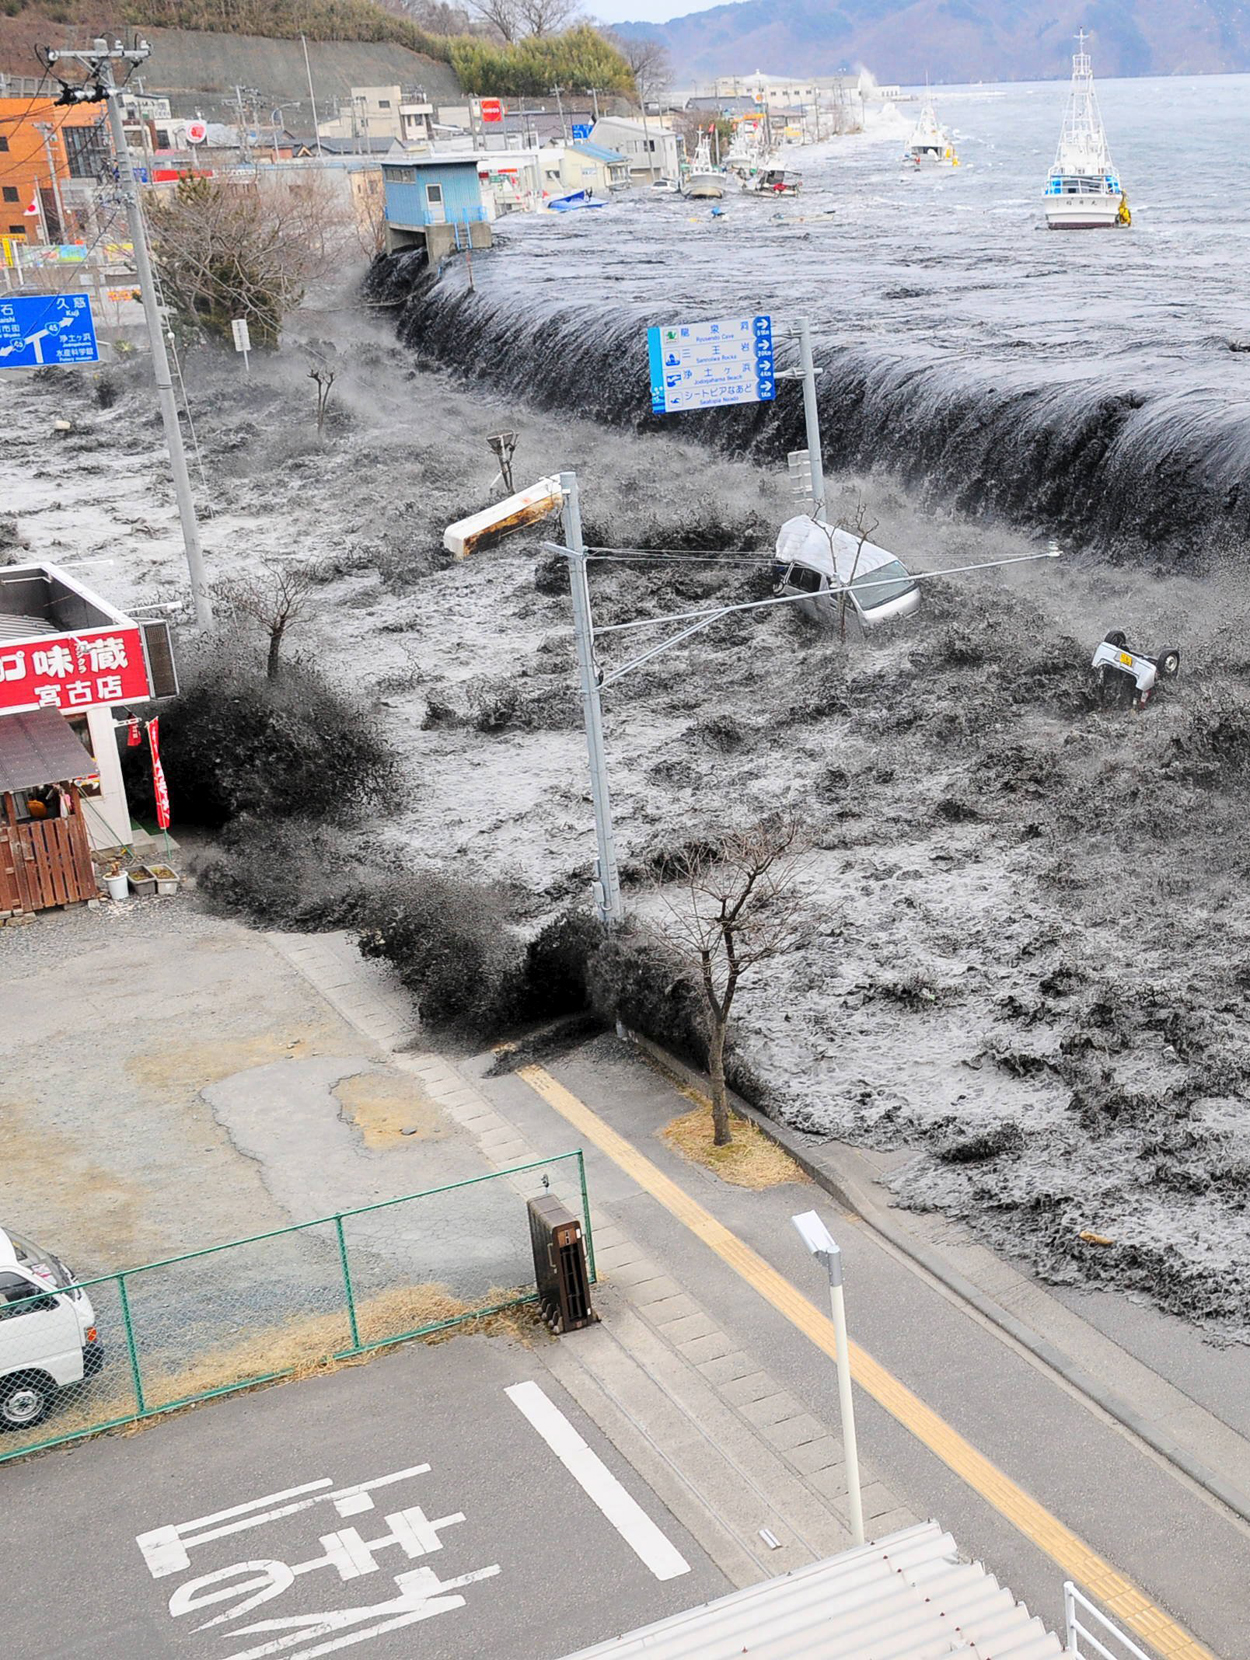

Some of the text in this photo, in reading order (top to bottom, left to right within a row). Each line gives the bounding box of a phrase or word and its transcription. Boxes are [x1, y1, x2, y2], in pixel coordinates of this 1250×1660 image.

[56, 297, 86, 309] 久慈
[682, 342, 749, 358] 三王岩
[685, 384, 752, 400] シートピアなあど
[34, 675, 123, 708] 宮古店
